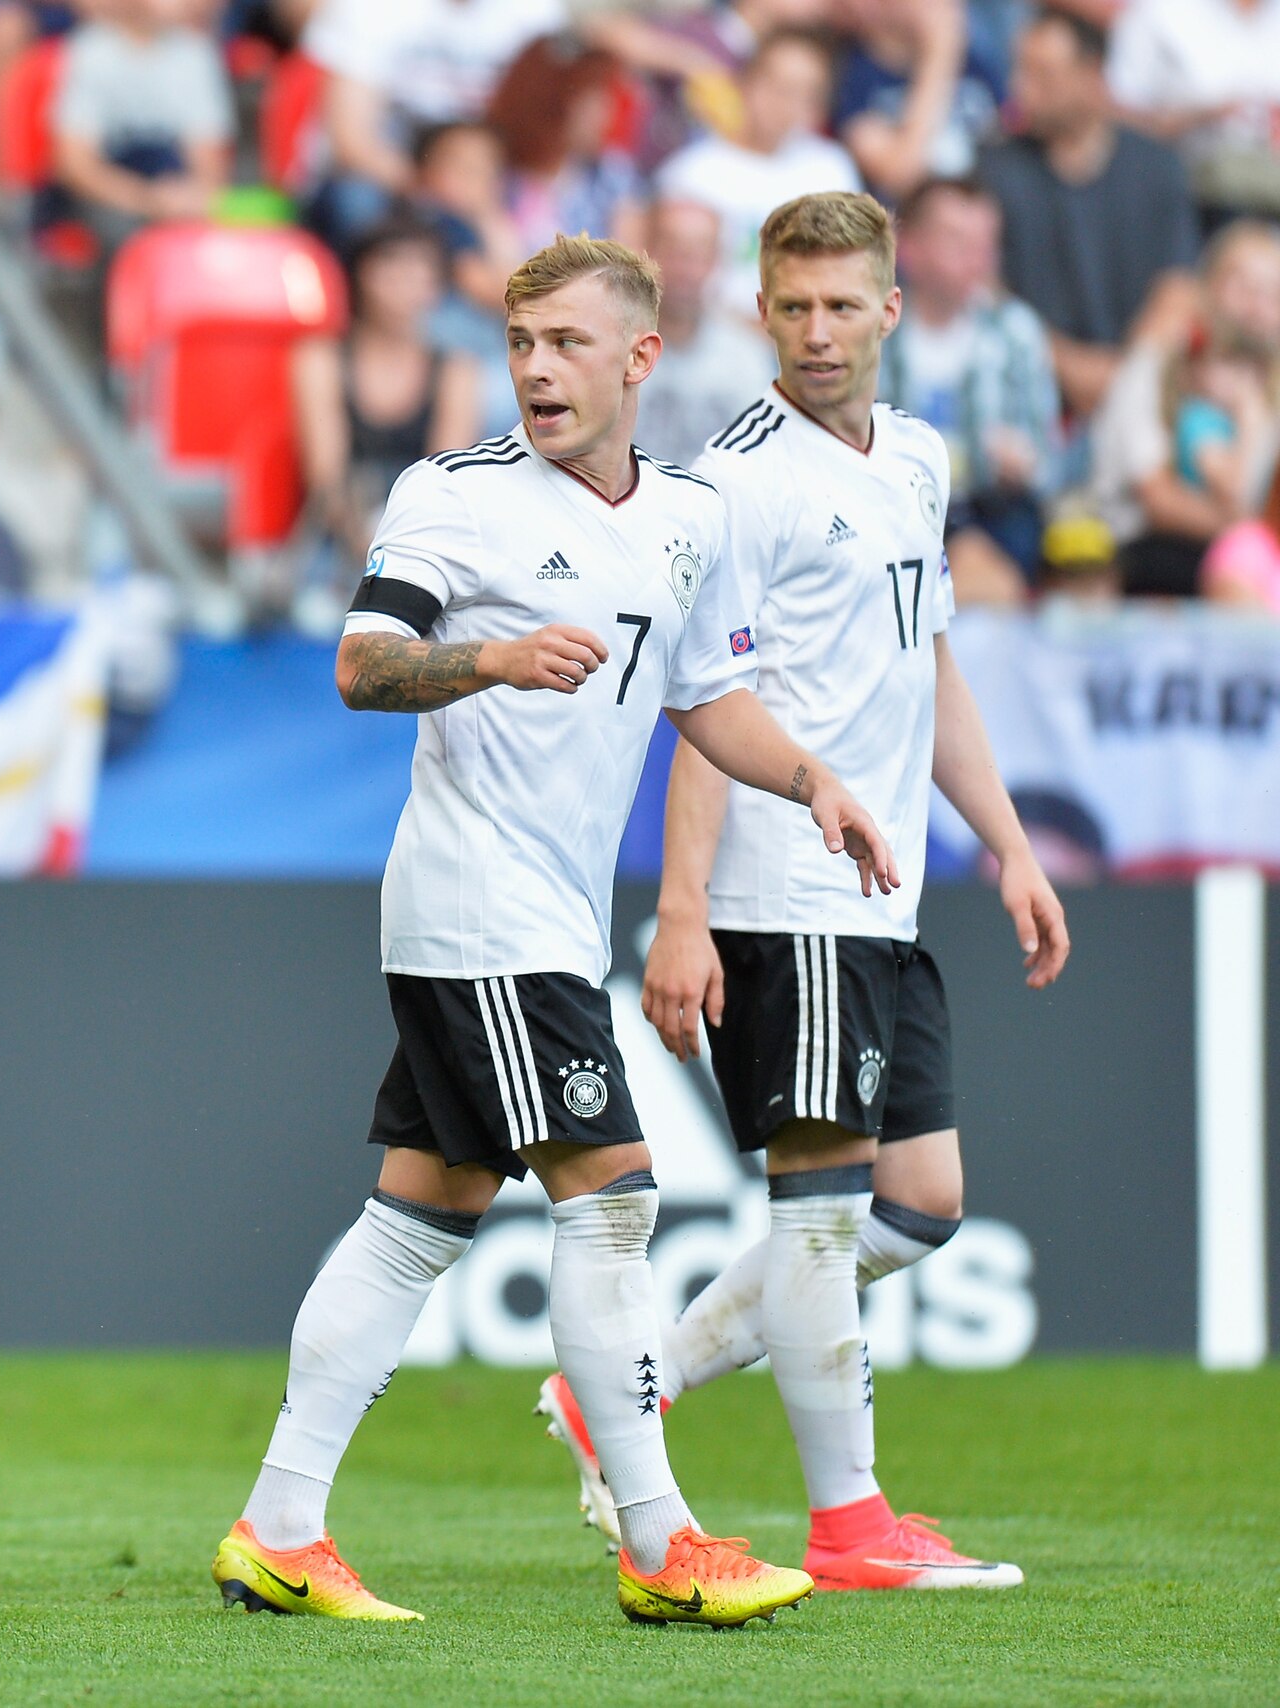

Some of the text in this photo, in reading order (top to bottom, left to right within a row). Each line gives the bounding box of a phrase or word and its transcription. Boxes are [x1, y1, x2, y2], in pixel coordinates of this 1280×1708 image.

[536, 568, 579, 580] adidas
[886, 558, 923, 649] 17
[616, 612, 652, 705] 7
